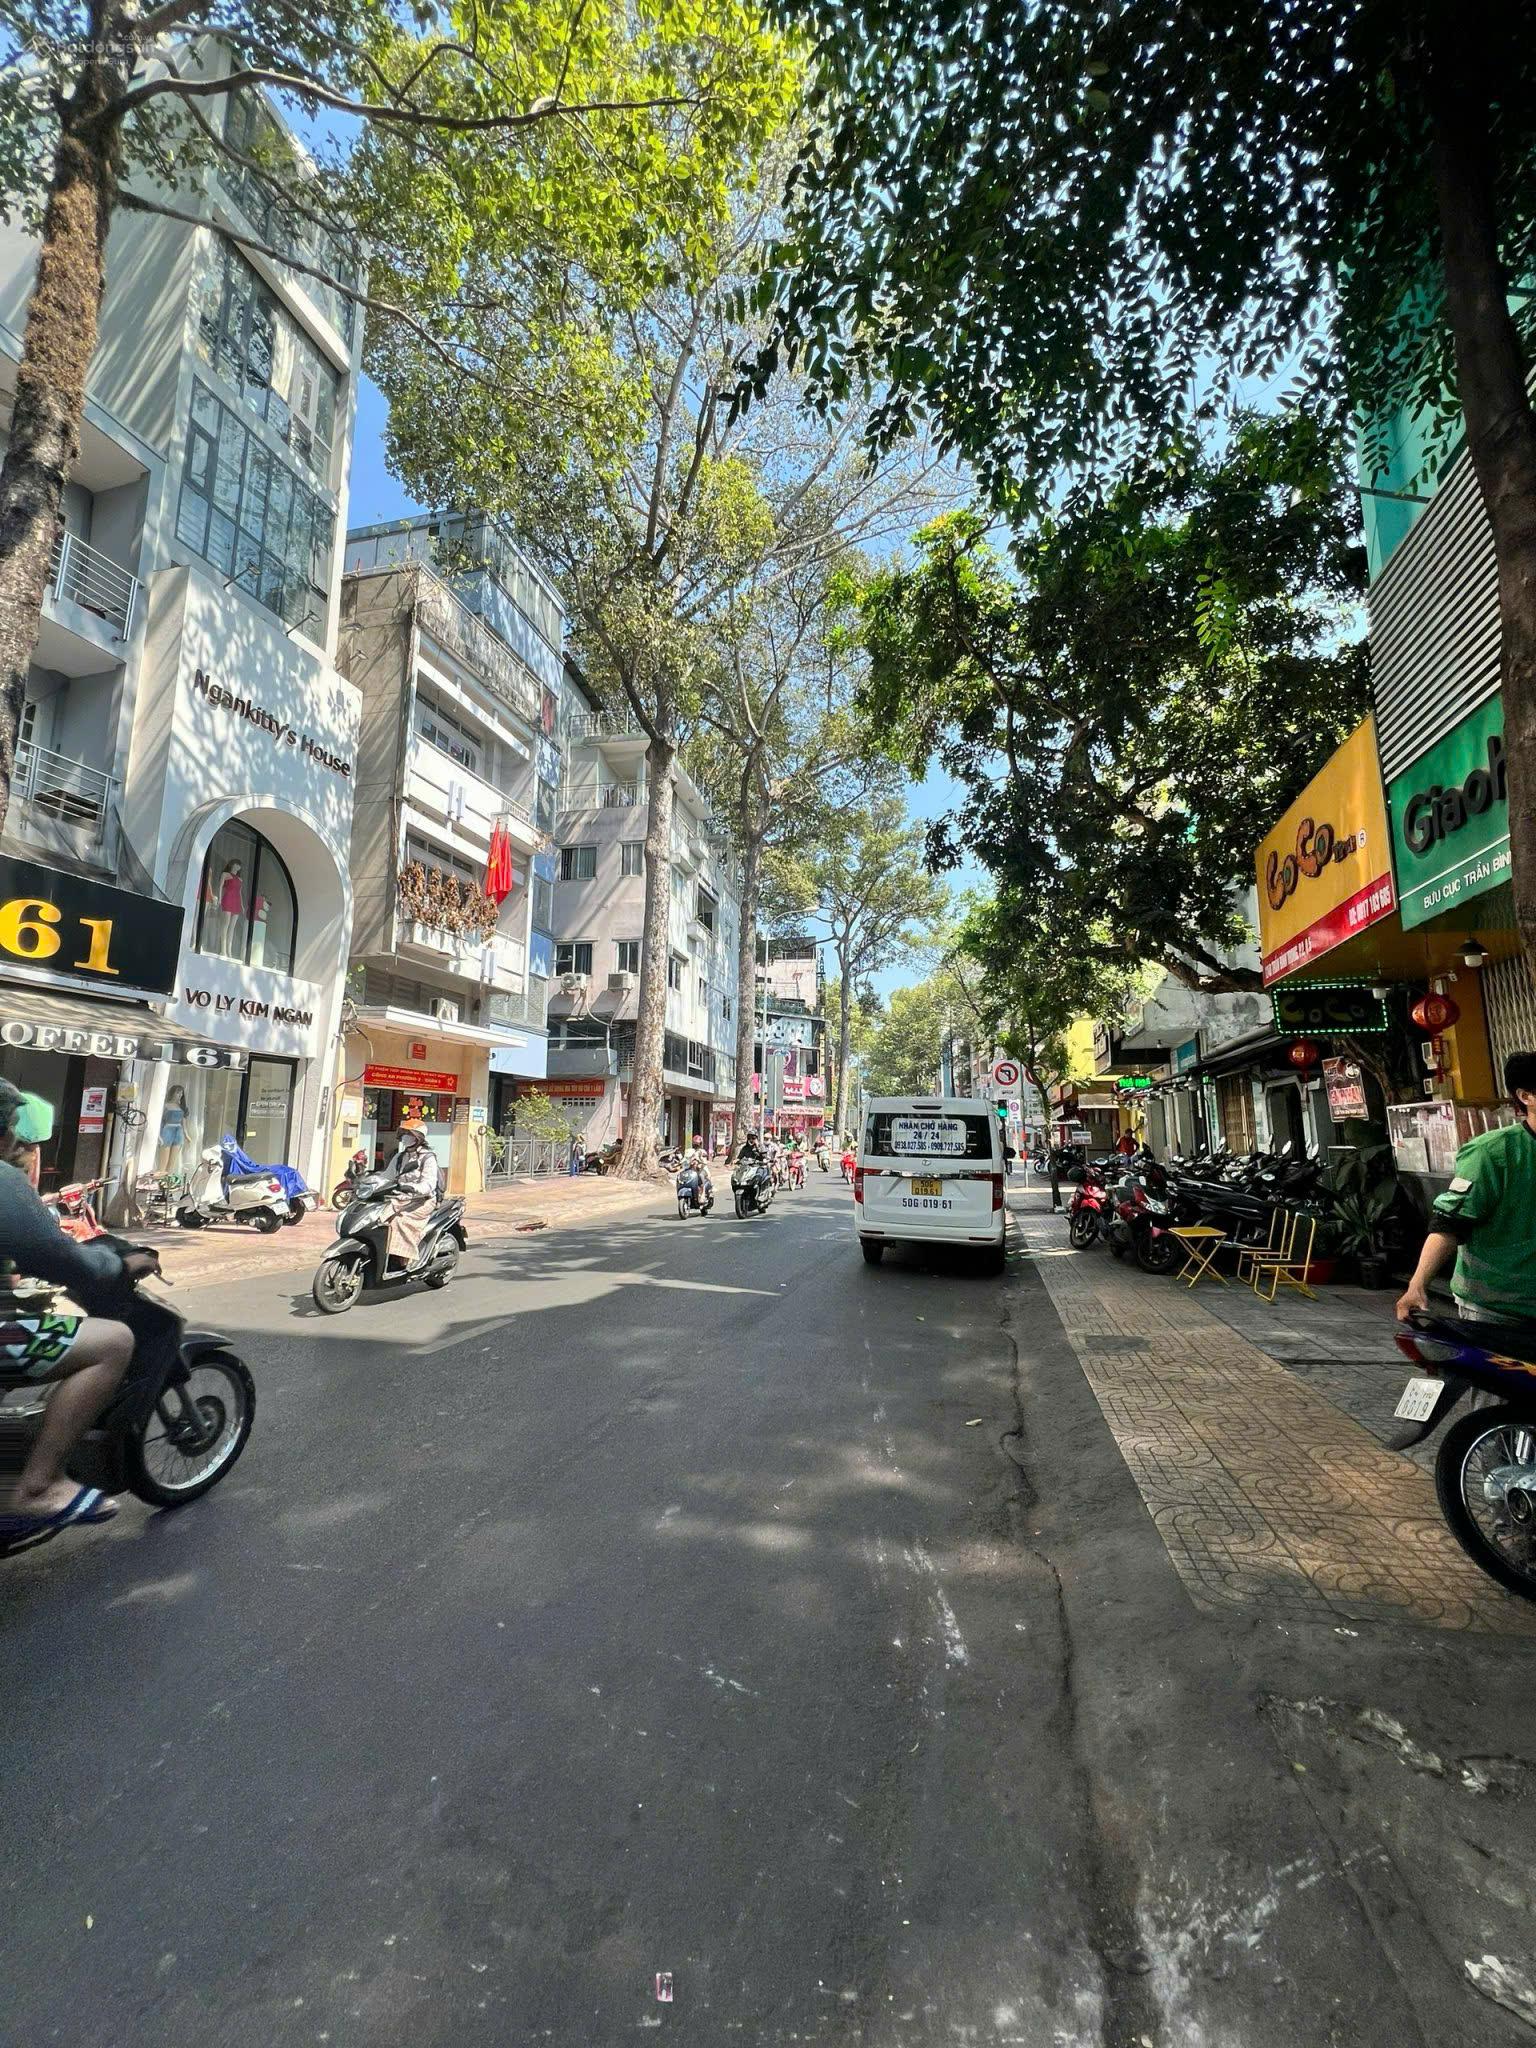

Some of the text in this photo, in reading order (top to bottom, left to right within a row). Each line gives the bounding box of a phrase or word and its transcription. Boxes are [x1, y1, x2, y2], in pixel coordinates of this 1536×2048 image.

[194, 668, 350, 777] Ngankitty's House
[1423, 889, 1441, 909] BƯU
[1463, 861, 1490, 887] TRẦN
[185, 987, 313, 1026] VO LY KIM NGAN
[152, 1041, 246, 1071] 161
